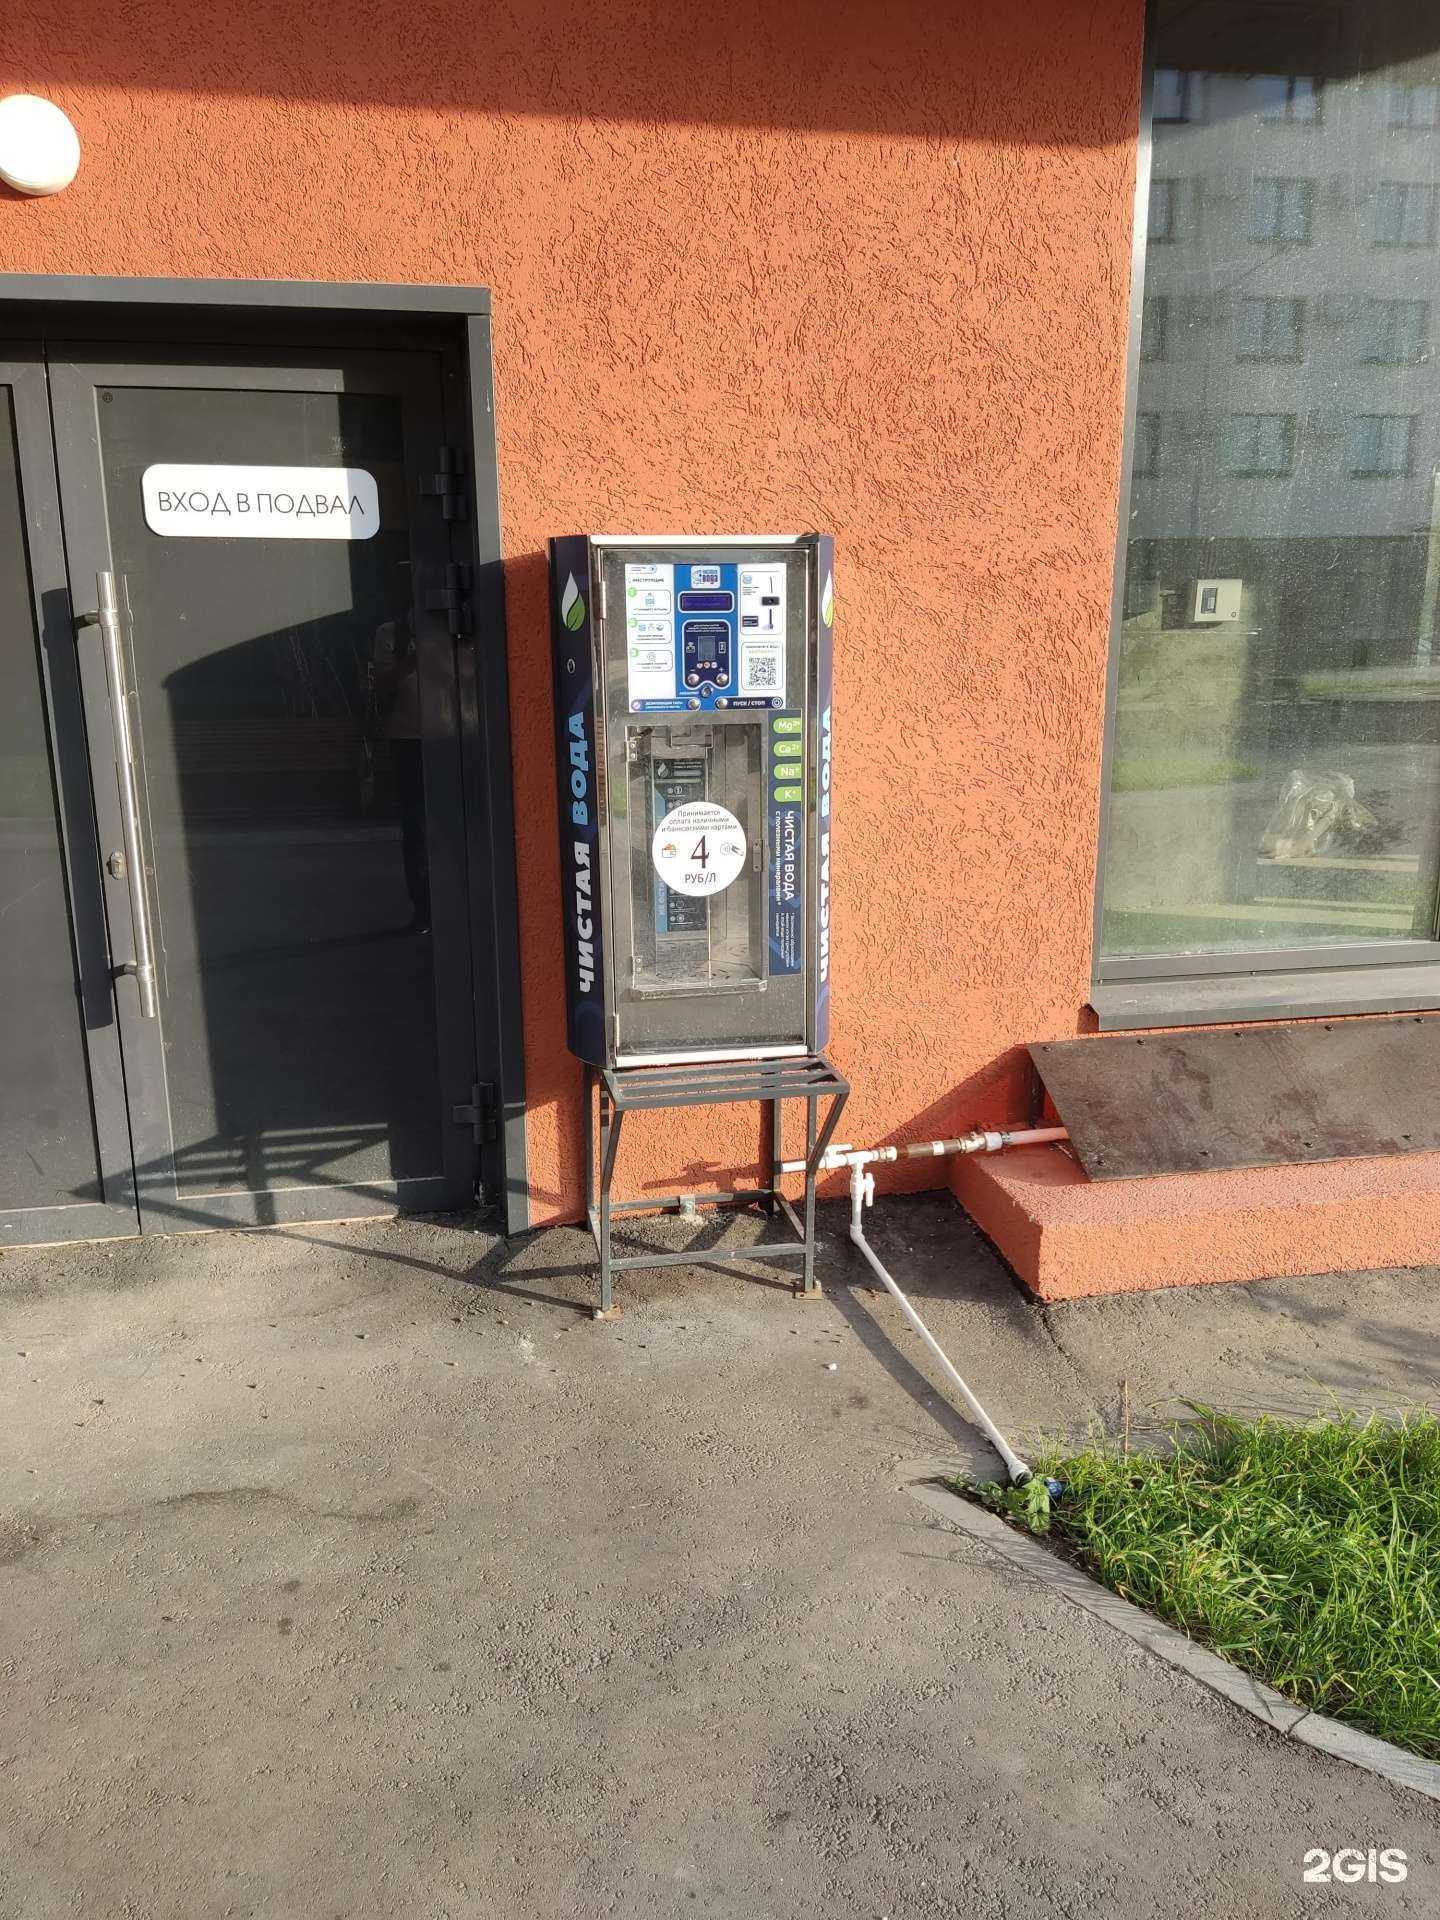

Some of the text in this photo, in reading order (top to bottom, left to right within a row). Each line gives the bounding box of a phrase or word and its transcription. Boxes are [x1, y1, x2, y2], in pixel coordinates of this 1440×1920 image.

[158, 491, 365, 517] ВХОД В ПОДВАЛ
[710, 824, 738, 832] картами
[784, 811, 795, 861] ЧИСТАЯ
[568, 711, 595, 993] ЧИСТАЯ ВОДА
[690, 834, 710, 869] 4
[684, 872, 716, 885] РУБ/Л
[782, 864, 795, 900] ВОДА
